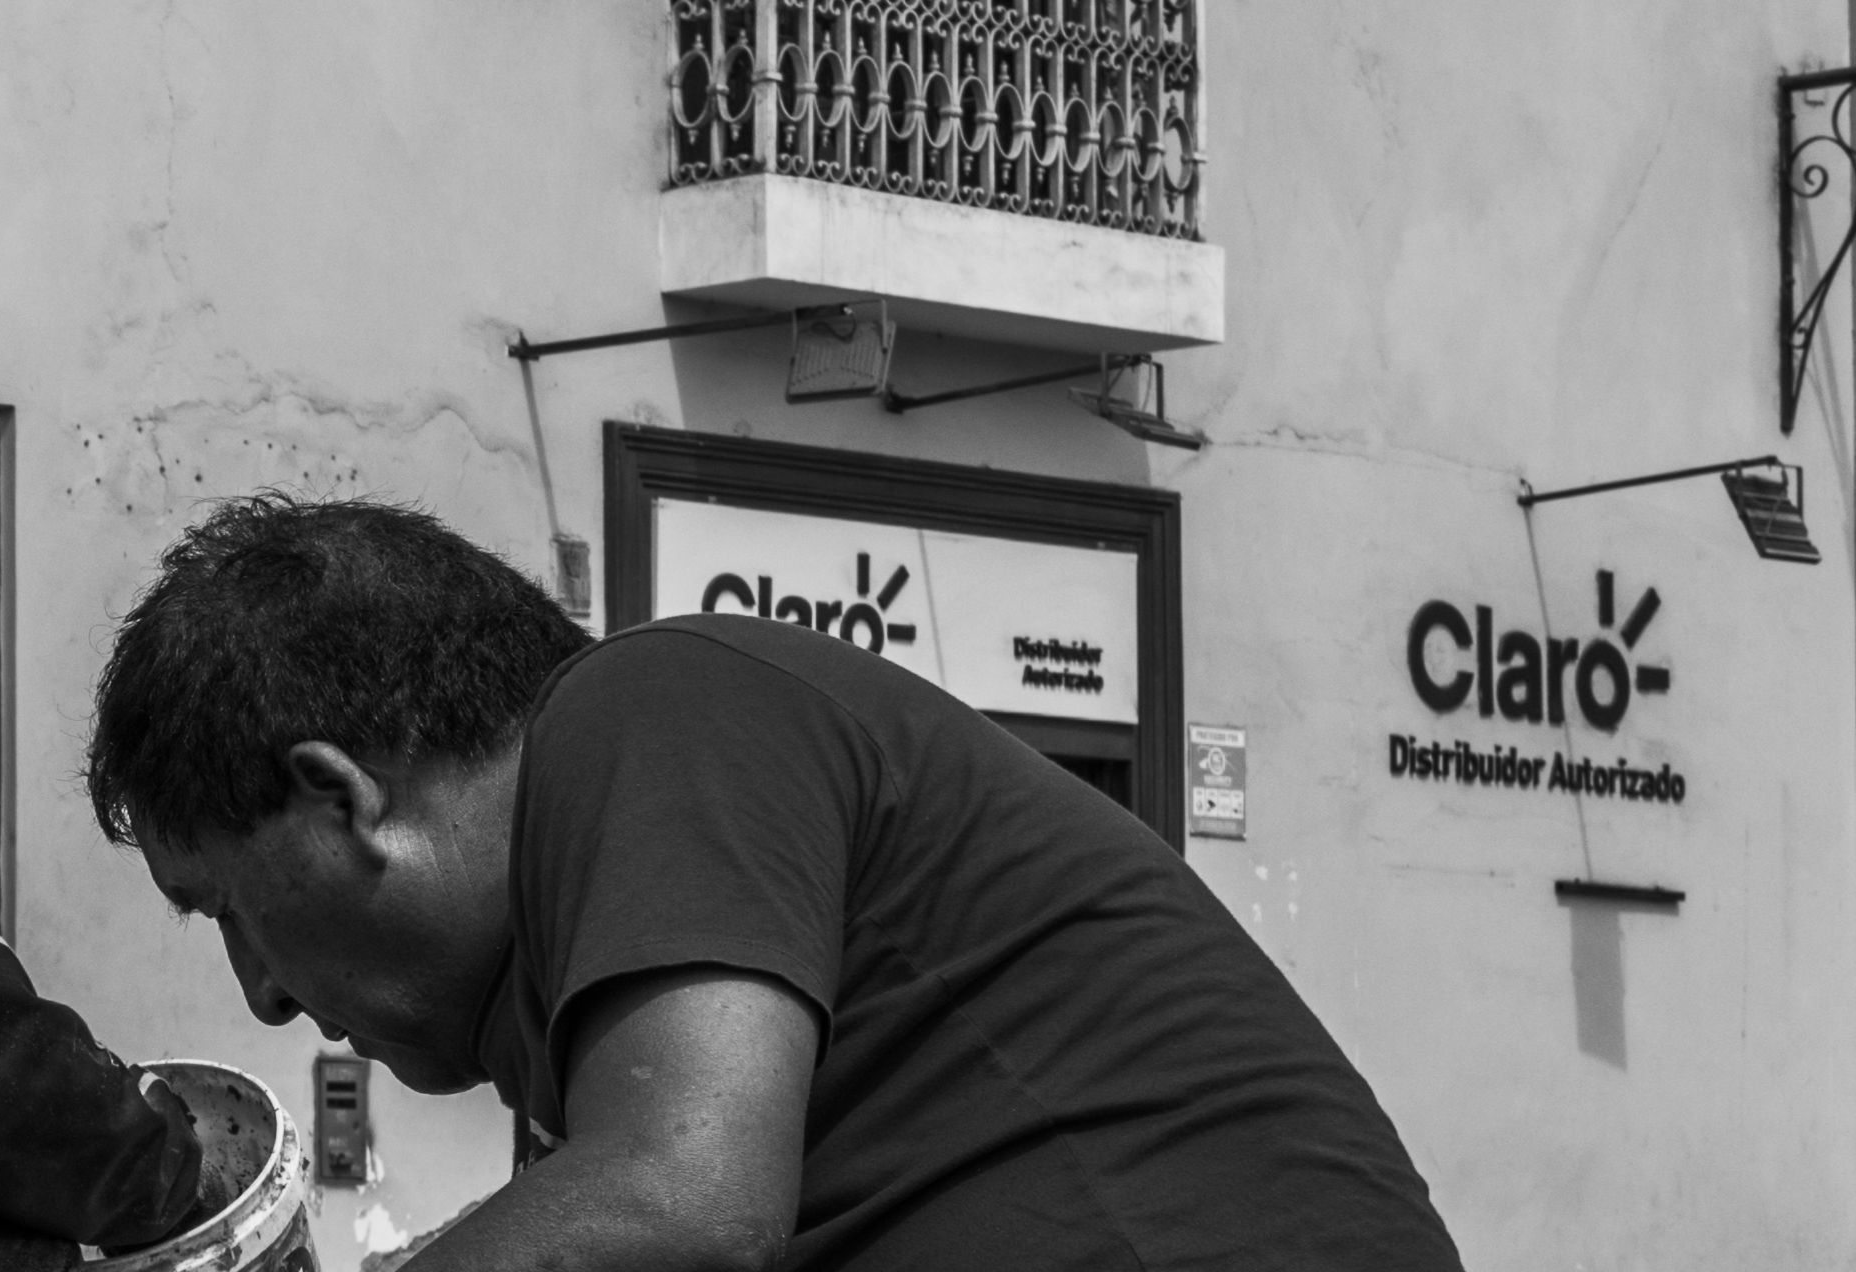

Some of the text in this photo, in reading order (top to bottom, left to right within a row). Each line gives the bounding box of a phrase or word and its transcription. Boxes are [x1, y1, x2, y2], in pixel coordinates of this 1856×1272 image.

[1013, 636, 1104, 666] Distribuidor
[1406, 598, 1632, 737] Claro
[1022, 665, 1105, 694] Autorizado
[1388, 732, 1687, 806] Distribuidor Autorizado
